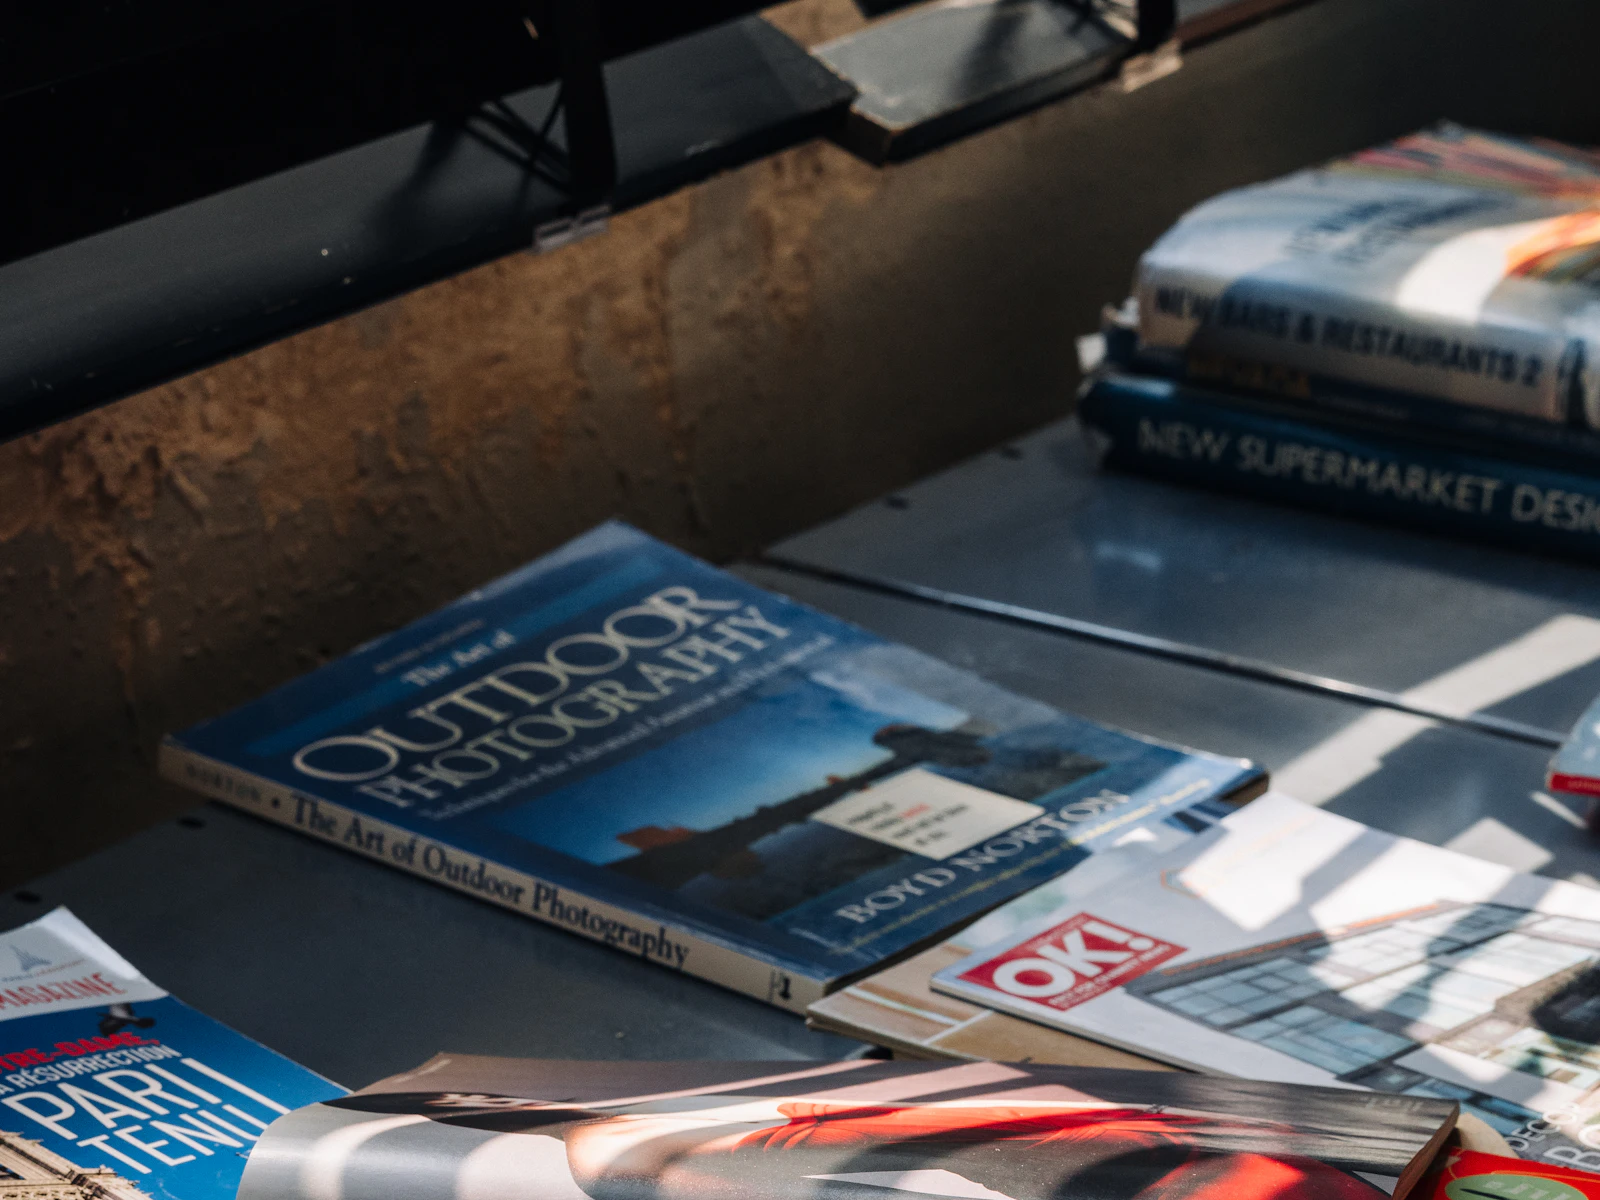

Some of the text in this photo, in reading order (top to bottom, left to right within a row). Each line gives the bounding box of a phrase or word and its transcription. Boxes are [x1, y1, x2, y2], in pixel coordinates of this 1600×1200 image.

[1297, 312, 1318, 342] &
[1323, 316, 1520, 376] RESTAURANTS
[1522, 358, 1544, 386] 2
[1138, 420, 1227, 462] NEW
[1235, 436, 1500, 514] SUPERMARKET
[291, 584, 742, 782] OUTDOOR
[358, 604, 792, 808] PHOTOGRAPHY
[400, 662, 452, 688] The
[290, 792, 340, 842] The
[344, 816, 386, 858] Art
[392, 838, 420, 866] of
[422, 848, 528, 906] Outdoor
[530, 880, 692, 972] Photography
[834, 866, 958, 924] BOYD
[950, 788, 1130, 872] NORTON
[992, 920, 1156, 998] OK!
[4, 1063, 222, 1140] PARI
[12, 1044, 184, 1092] RÉSURRECTION
[74, 1105, 270, 1176] TENU
